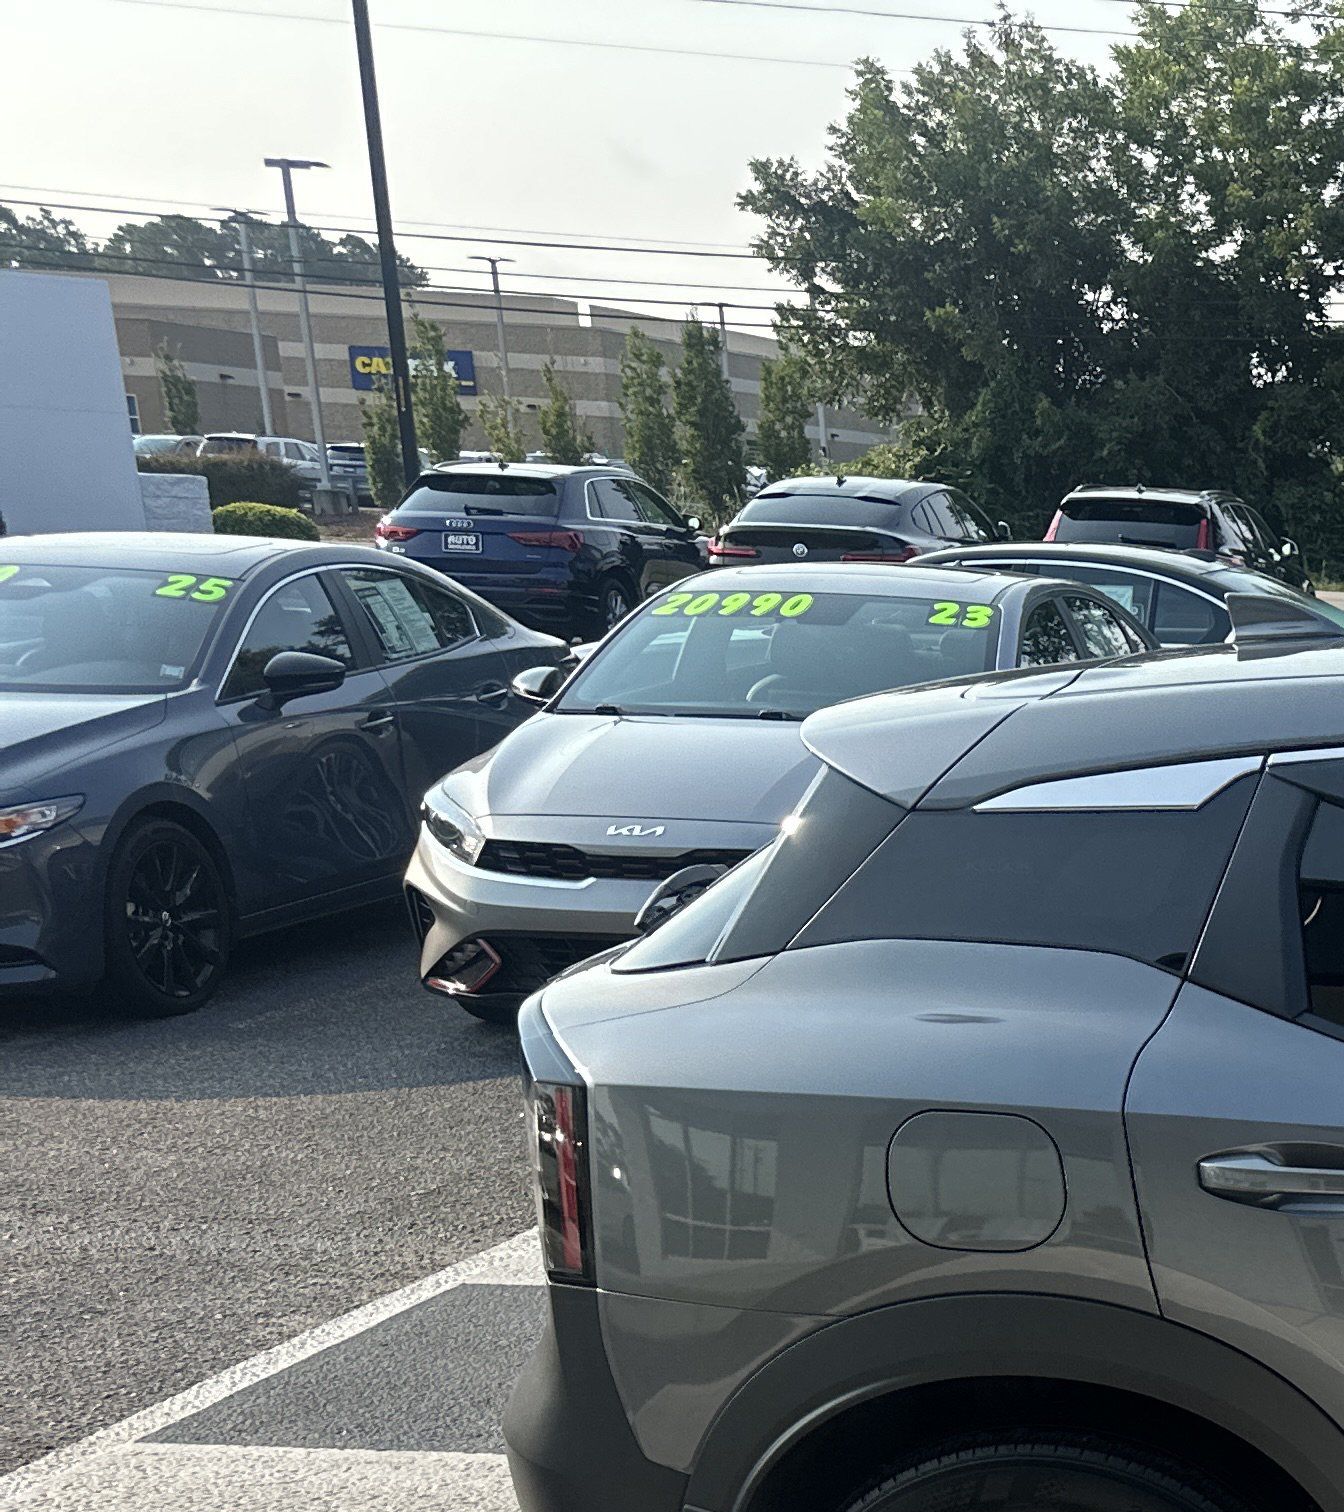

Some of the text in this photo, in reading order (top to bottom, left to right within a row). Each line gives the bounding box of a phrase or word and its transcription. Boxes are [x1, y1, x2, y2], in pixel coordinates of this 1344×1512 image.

[447, 535, 476, 545] AUTO
[154, 574, 234, 603] 25
[651, 592, 994, 630] 20990 23
